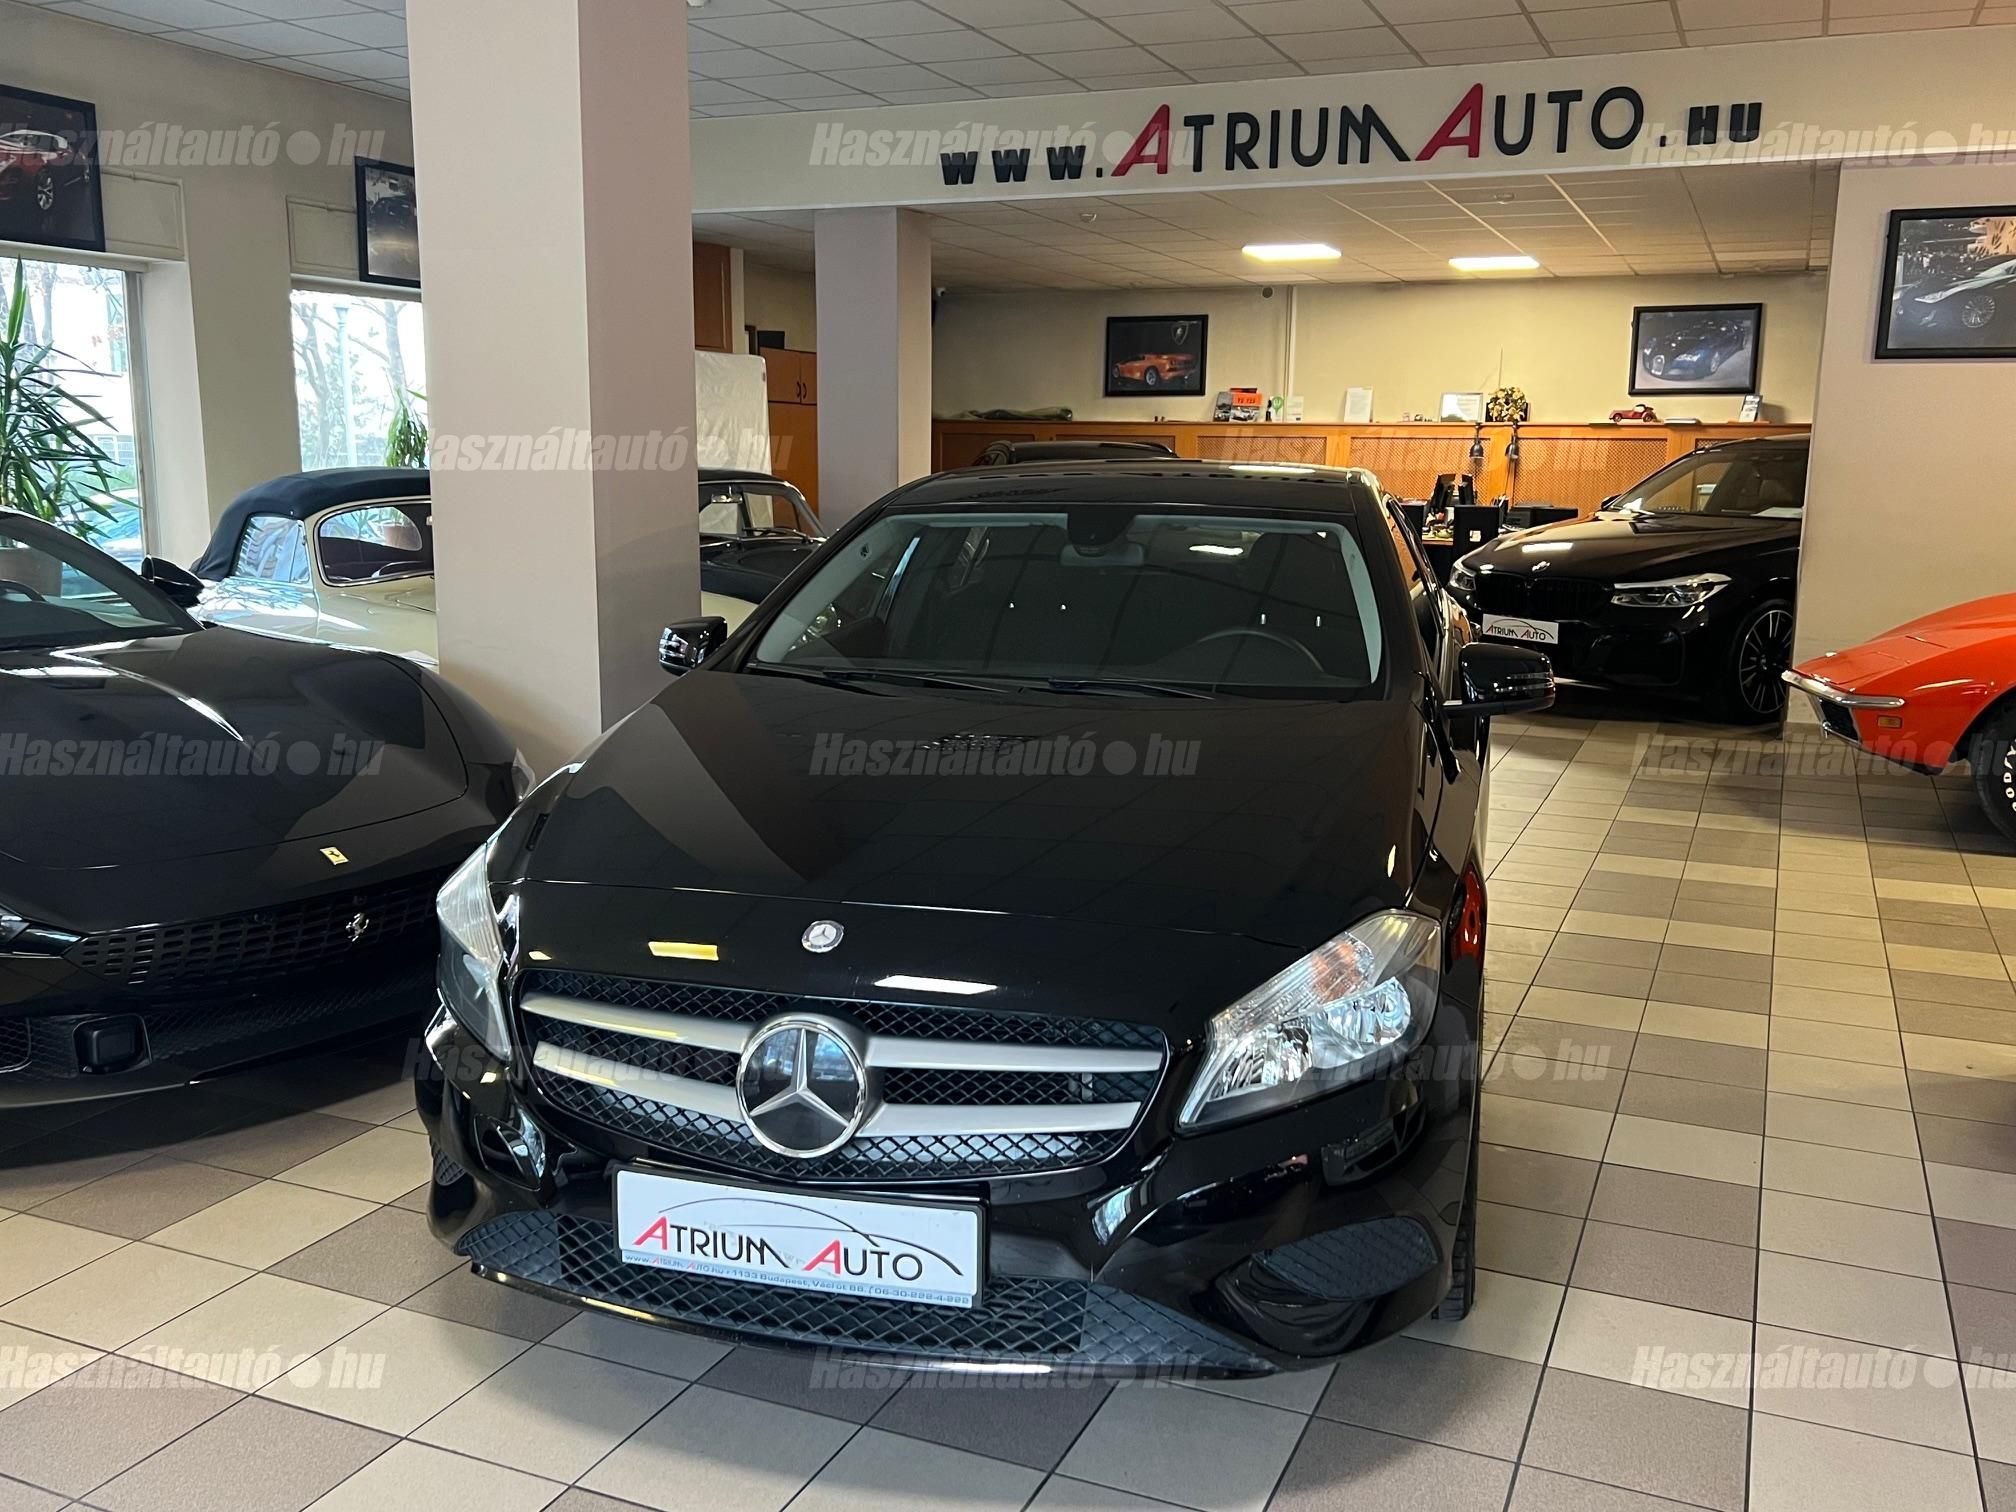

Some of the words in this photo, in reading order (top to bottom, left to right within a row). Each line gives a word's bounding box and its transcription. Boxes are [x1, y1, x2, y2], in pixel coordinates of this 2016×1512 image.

[1485, 624, 1519, 638] ATRIUM
[1520, 629, 1546, 641] AUTO
[632, 1216, 790, 1269] ATRIUM
[802, 1239, 923, 1282] AUTO
